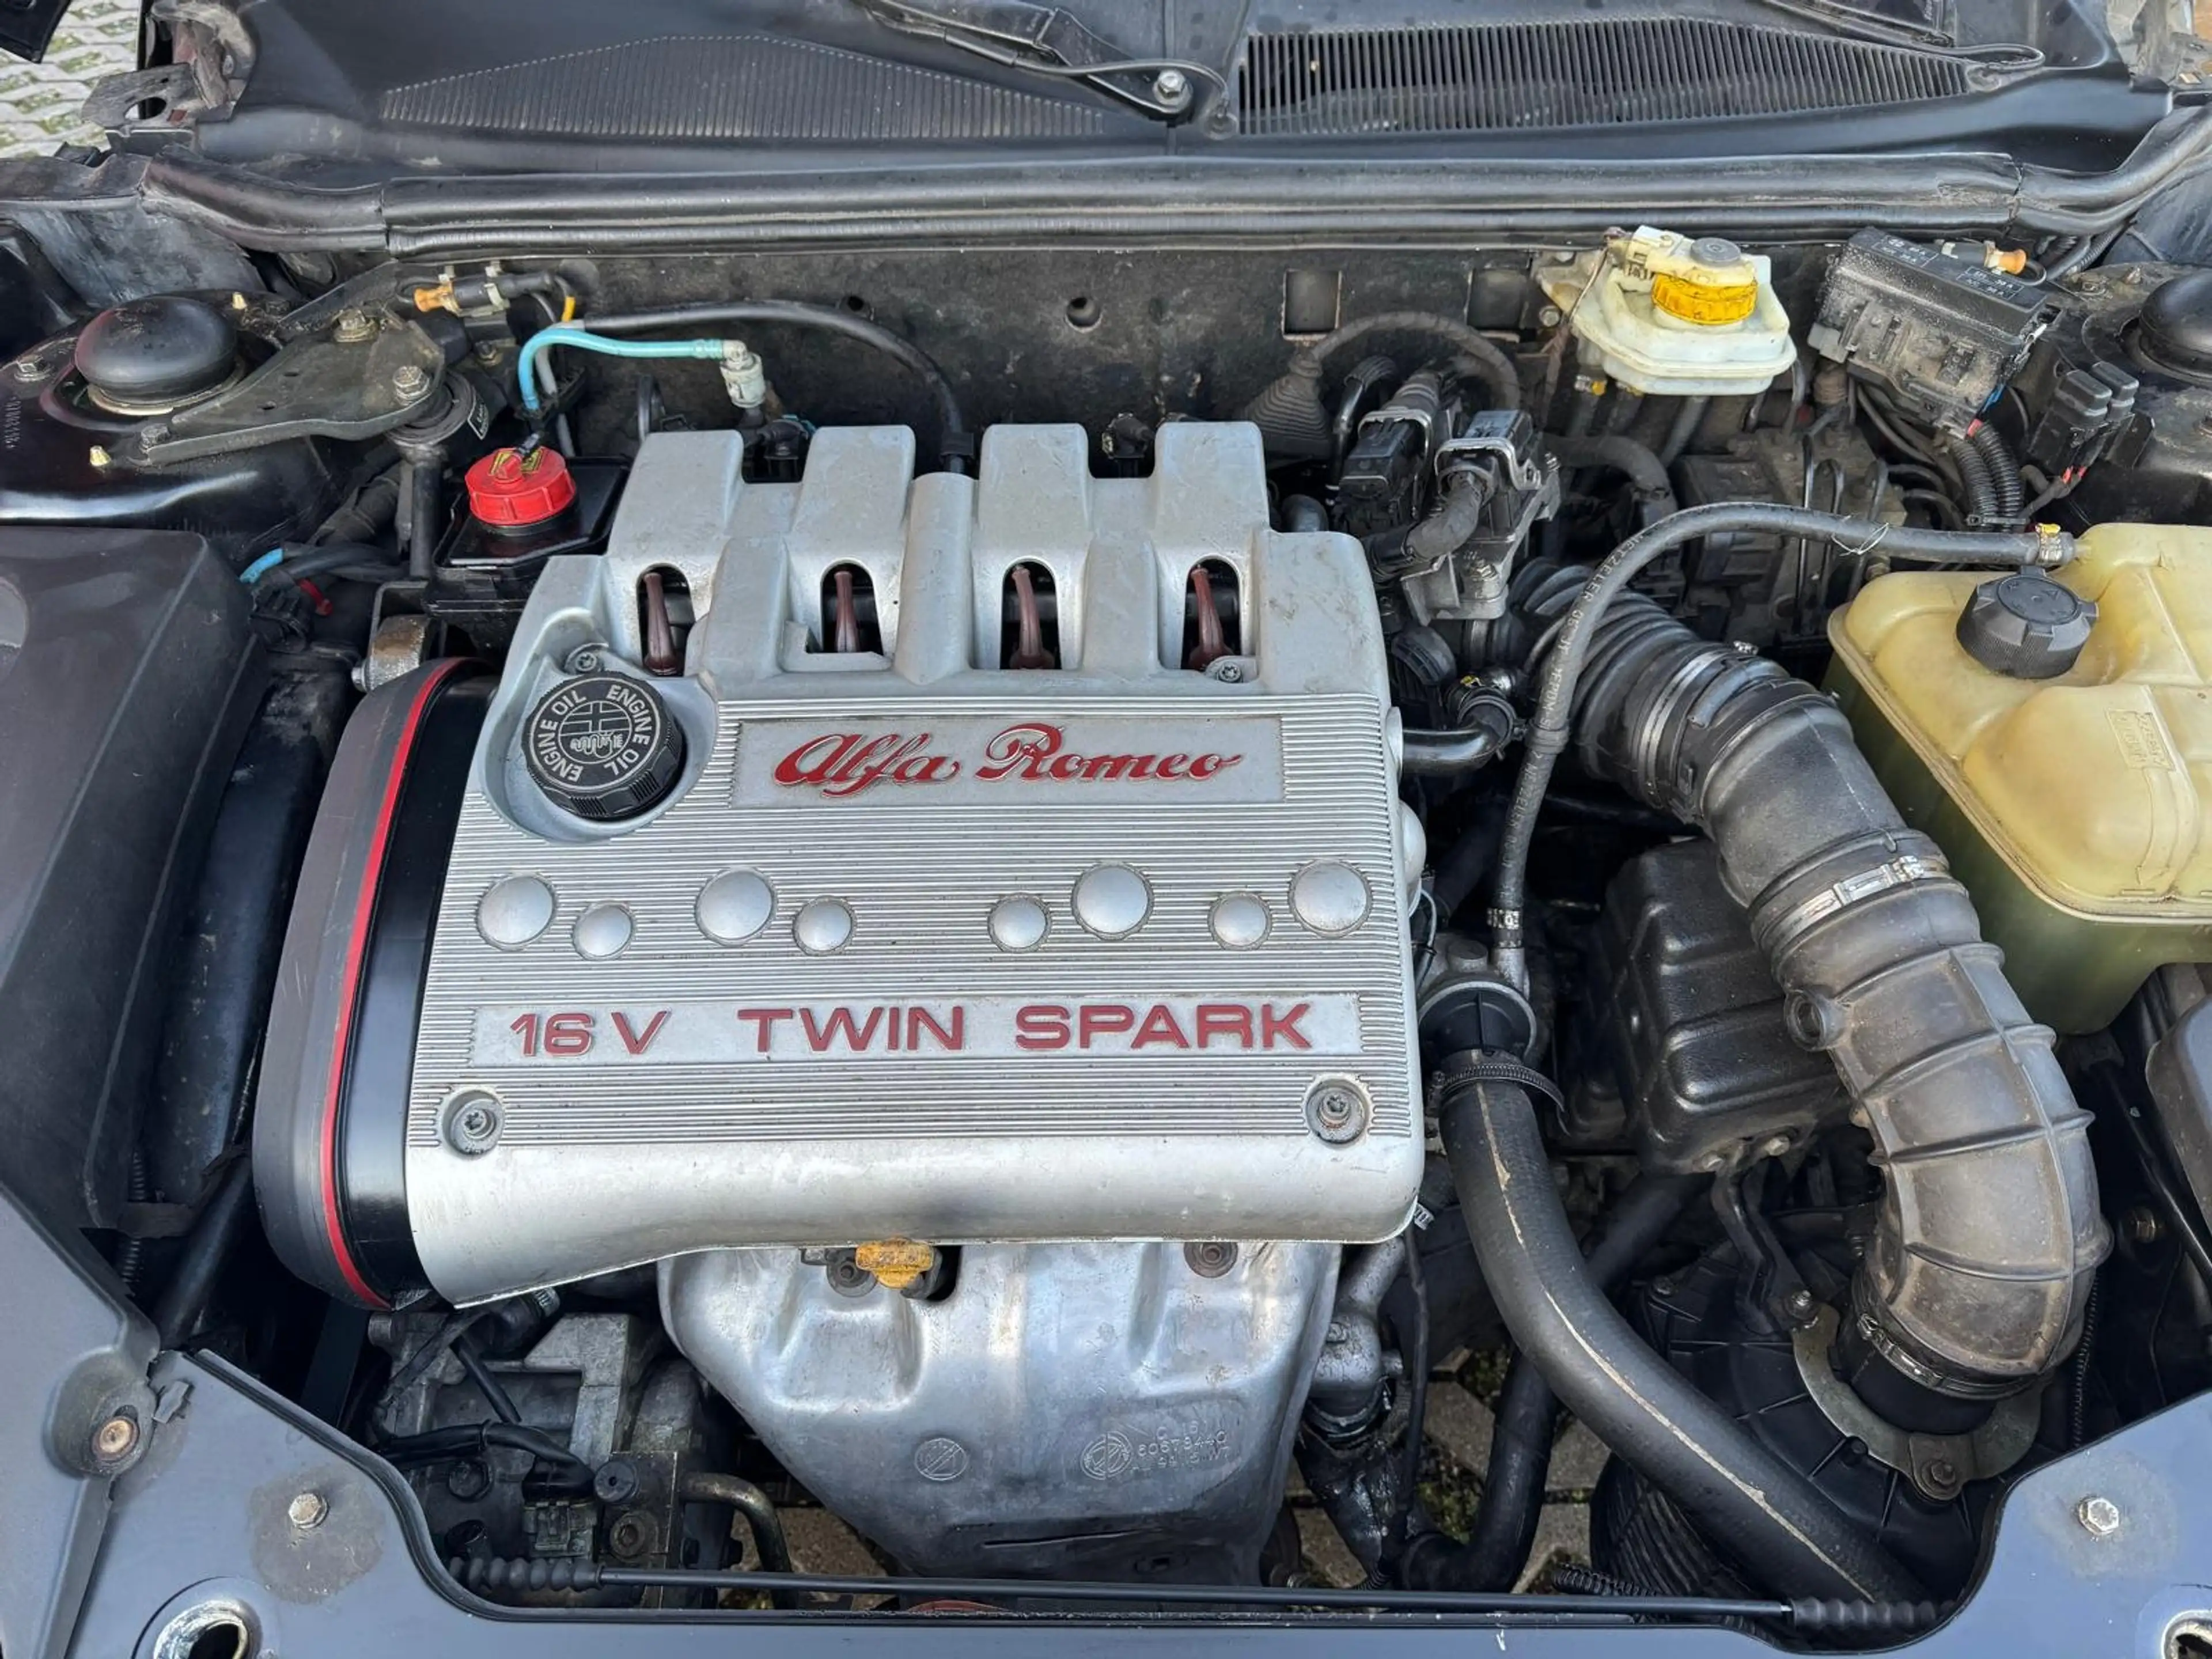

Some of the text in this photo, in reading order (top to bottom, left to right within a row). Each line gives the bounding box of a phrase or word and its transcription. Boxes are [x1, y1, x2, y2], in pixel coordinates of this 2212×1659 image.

[538, 690, 586, 782] ENGINE OIL
[604, 684, 653, 775] ENGINE OIL
[774, 722, 1243, 798] Alfa Romeo
[737, 1005, 964, 1054] TWIN
[1014, 1003, 1313, 1051] SPARK
